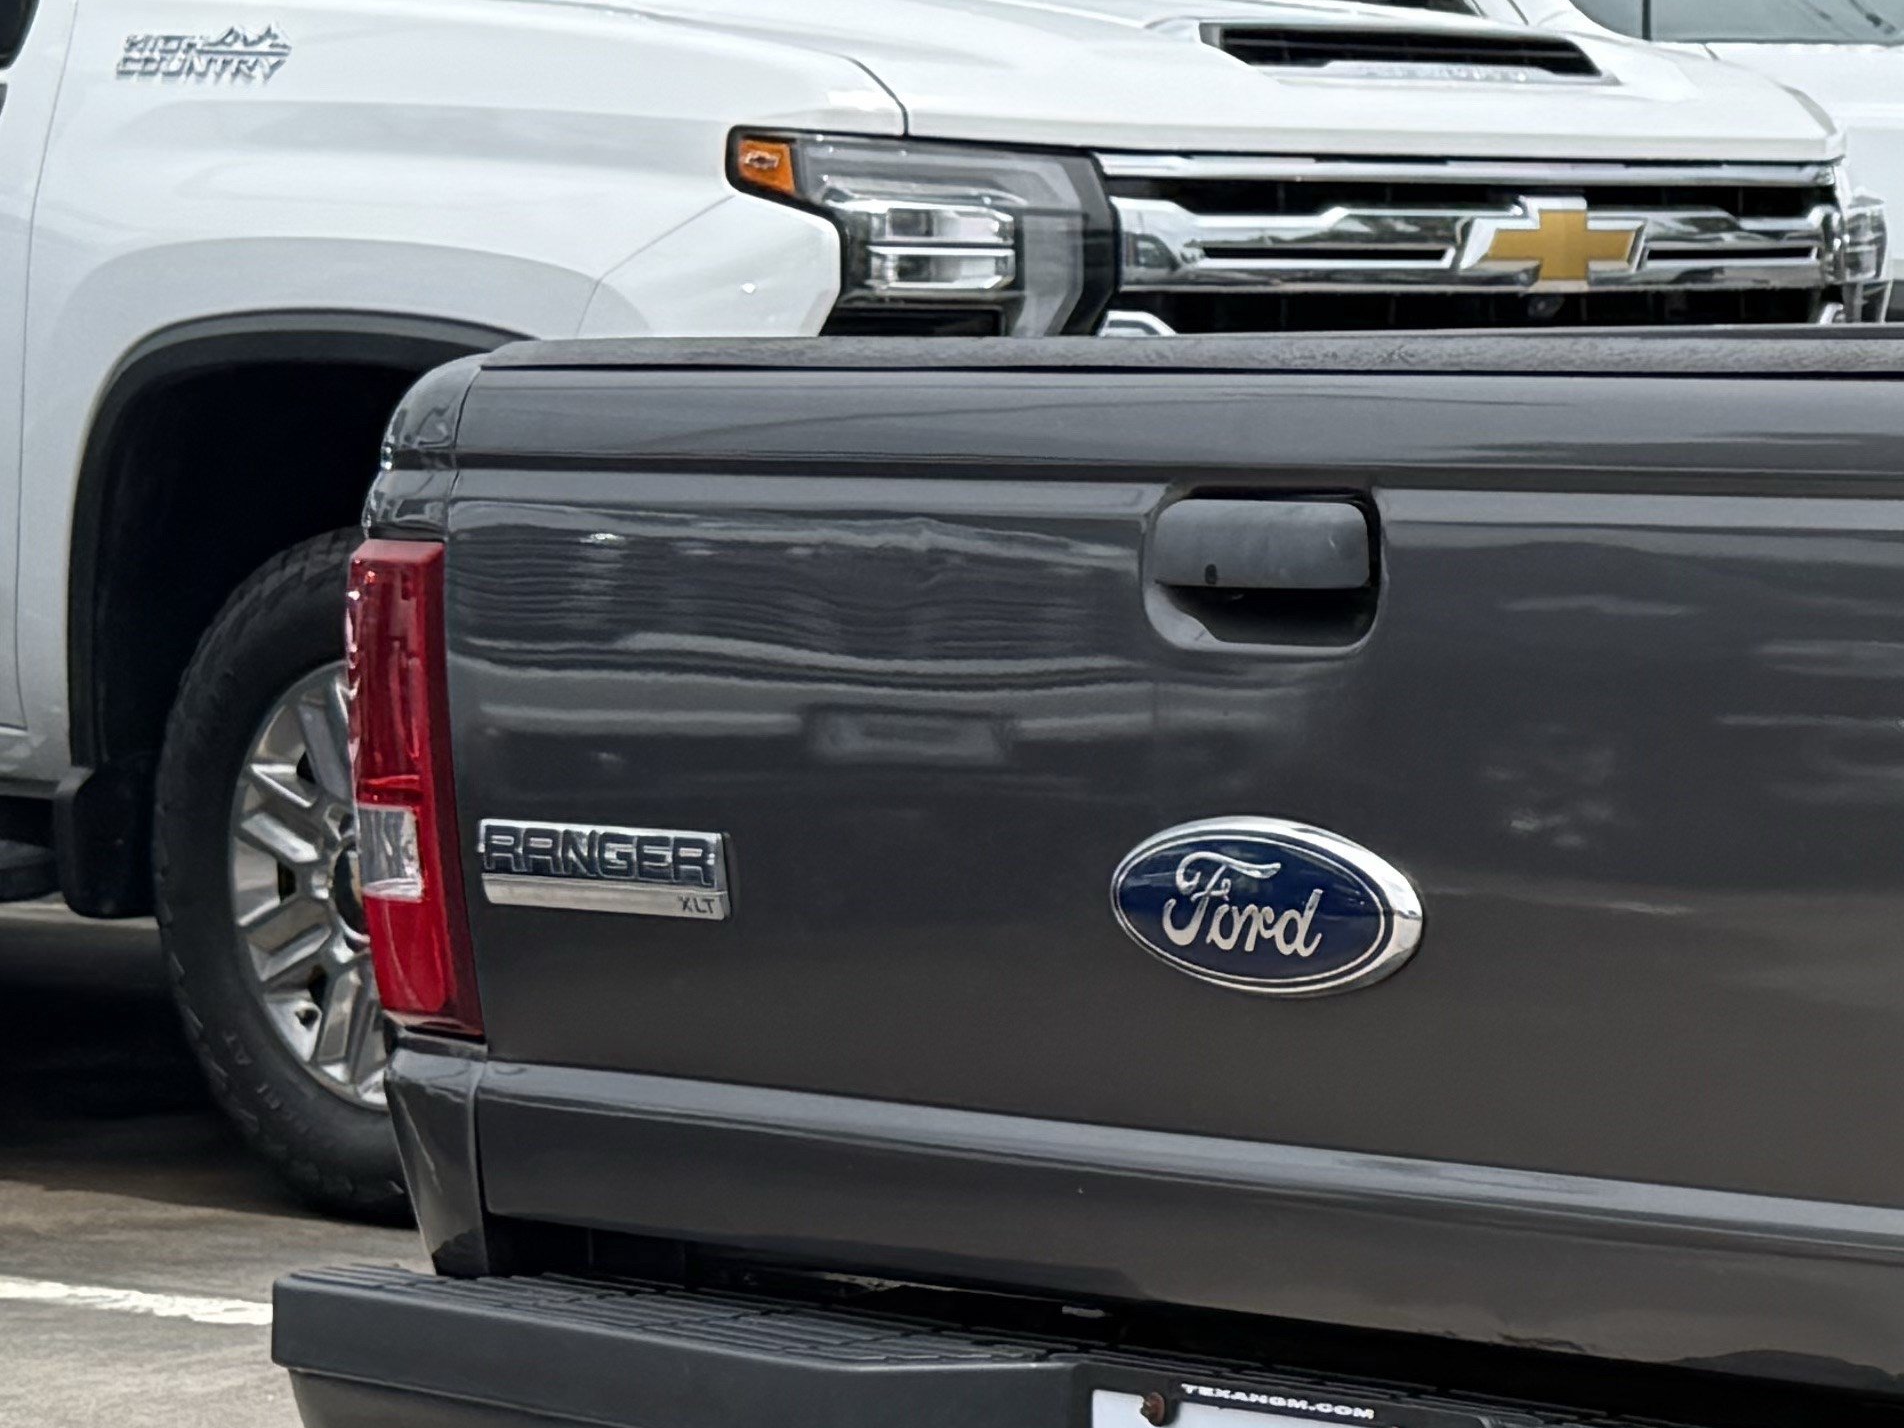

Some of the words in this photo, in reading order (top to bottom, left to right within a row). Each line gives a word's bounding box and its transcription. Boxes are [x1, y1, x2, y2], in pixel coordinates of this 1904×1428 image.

[115, 56, 287, 85] COUNTRY
[483, 823, 716, 890] RANGER
[676, 896, 716, 916] XLT
[1162, 851, 1324, 958] Ford
[1180, 1383, 1375, 1420] TEXANGM.COM
